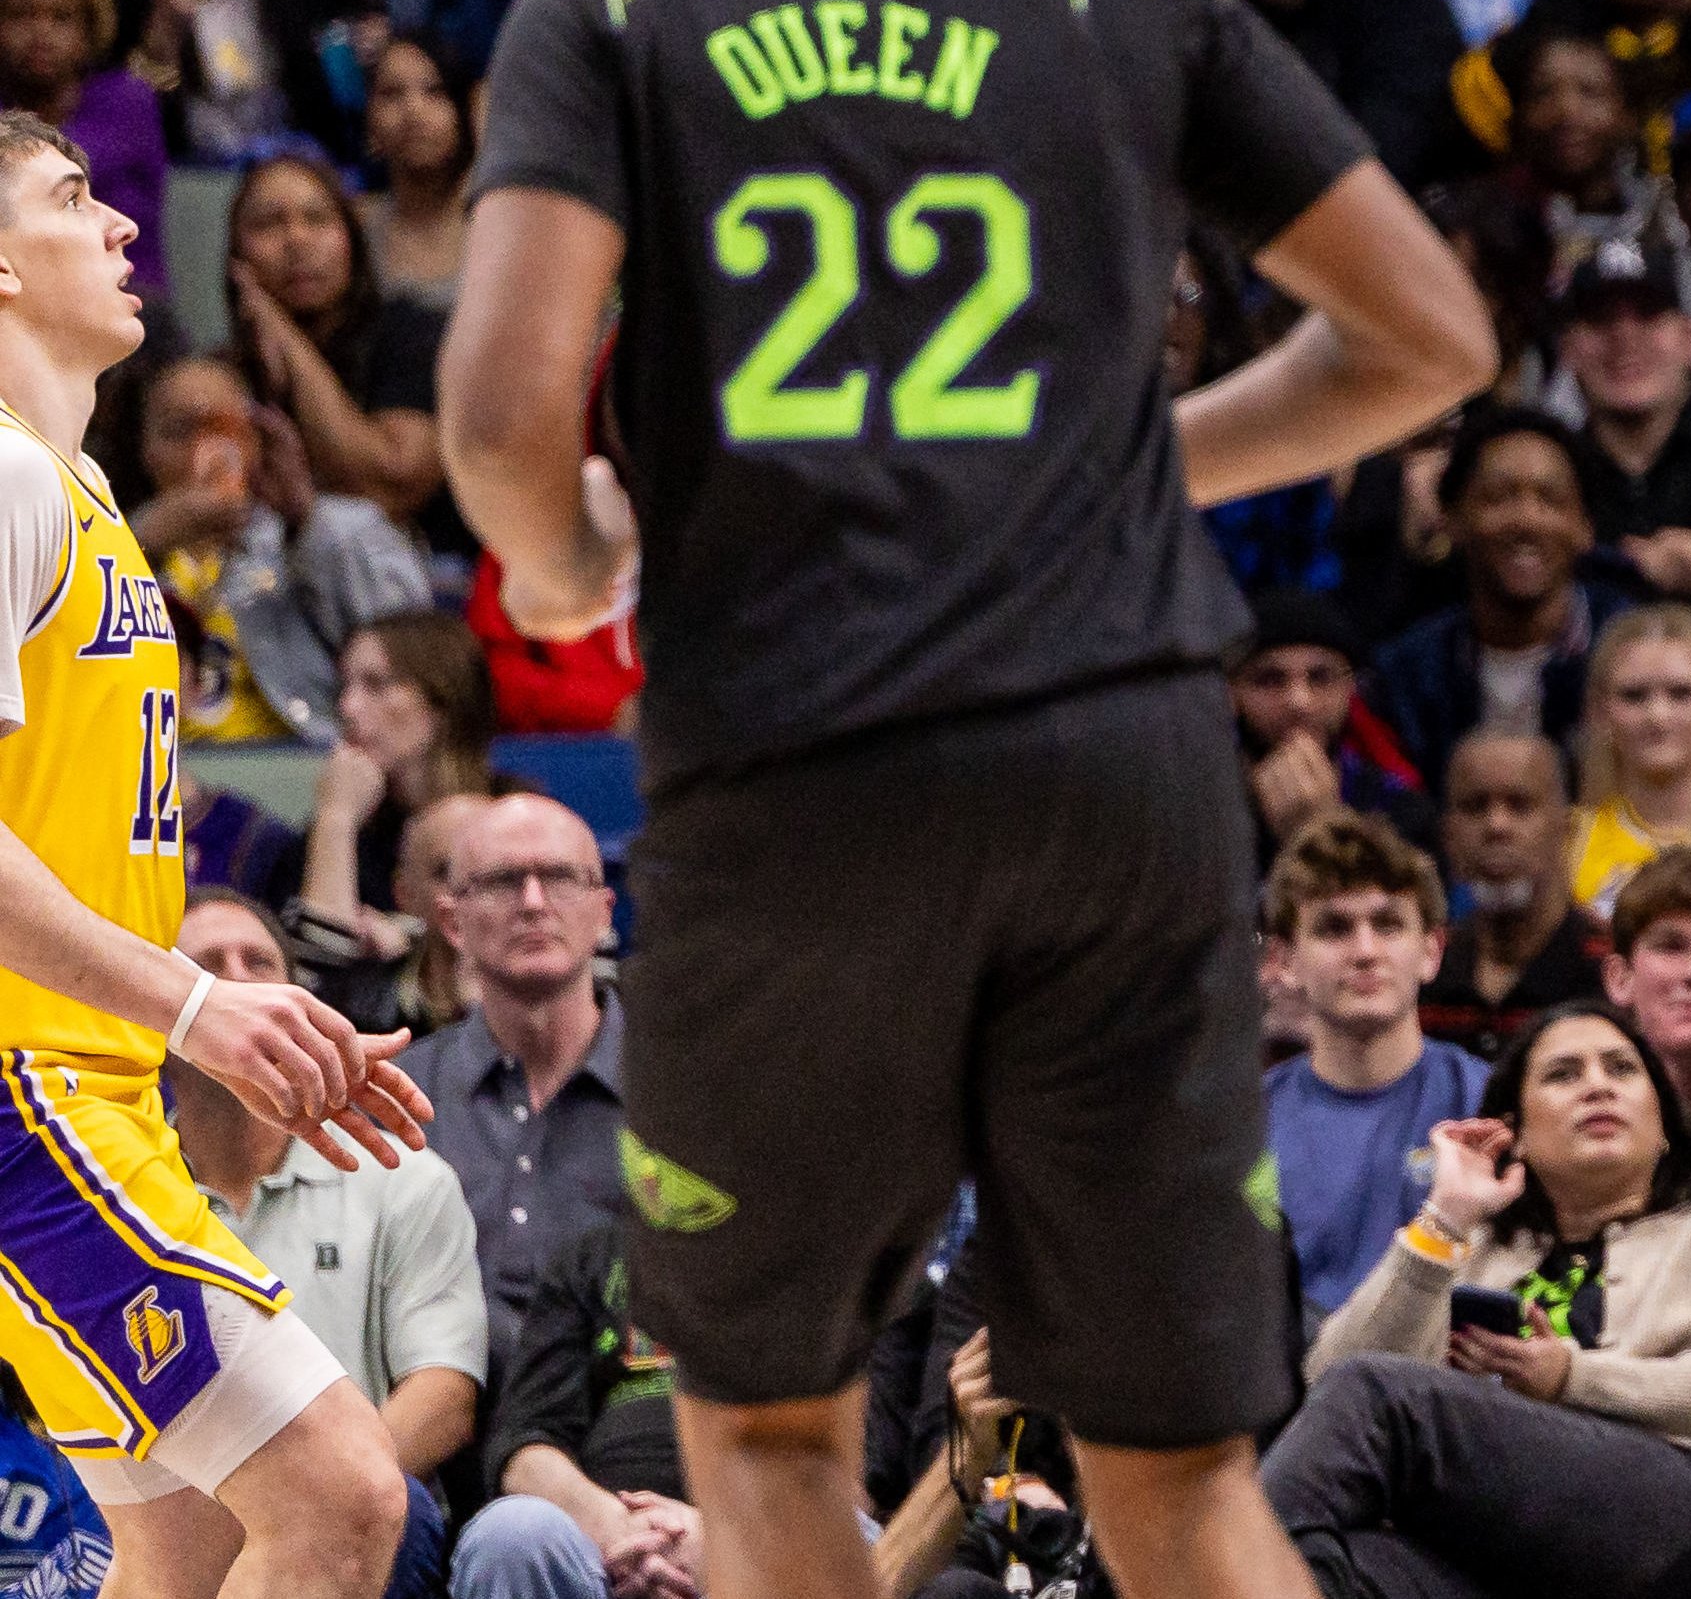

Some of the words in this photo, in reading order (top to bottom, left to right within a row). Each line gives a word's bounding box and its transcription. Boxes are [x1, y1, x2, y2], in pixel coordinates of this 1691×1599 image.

[711, 170, 1044, 443] 22
[76, 555, 177, 660] LAKE
[128, 688, 183, 857] 12
